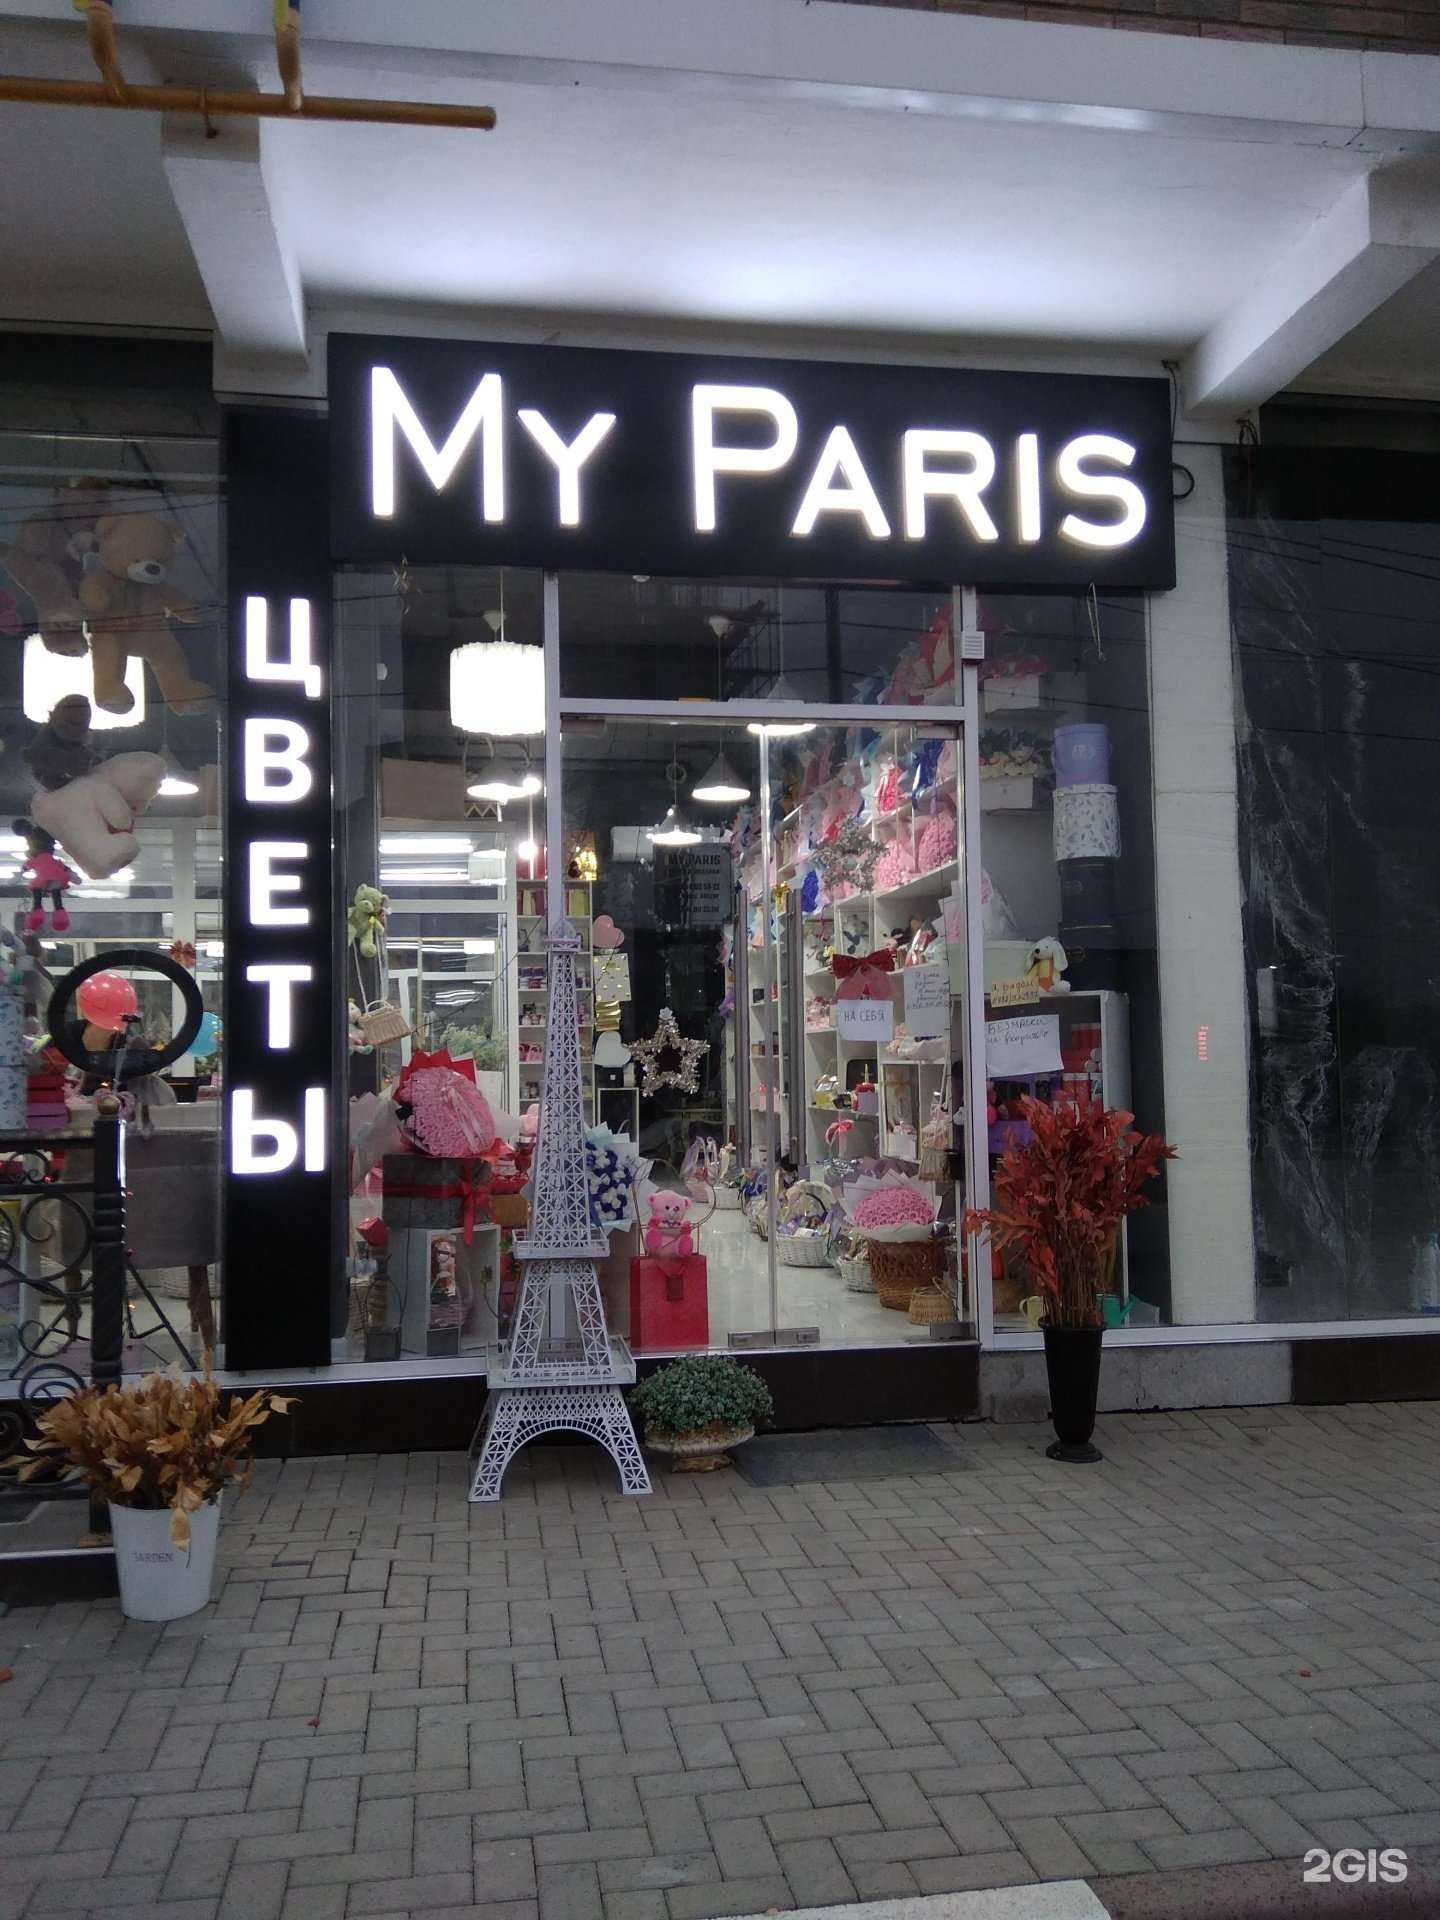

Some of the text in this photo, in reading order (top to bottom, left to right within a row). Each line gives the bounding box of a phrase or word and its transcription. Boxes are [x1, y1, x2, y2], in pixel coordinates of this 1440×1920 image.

[688, 854, 721, 865] PARIS
[230, 595, 326, 1175] ЦВЕТЫ
[844, 1009, 885, 1022] НА СЕБЯ
